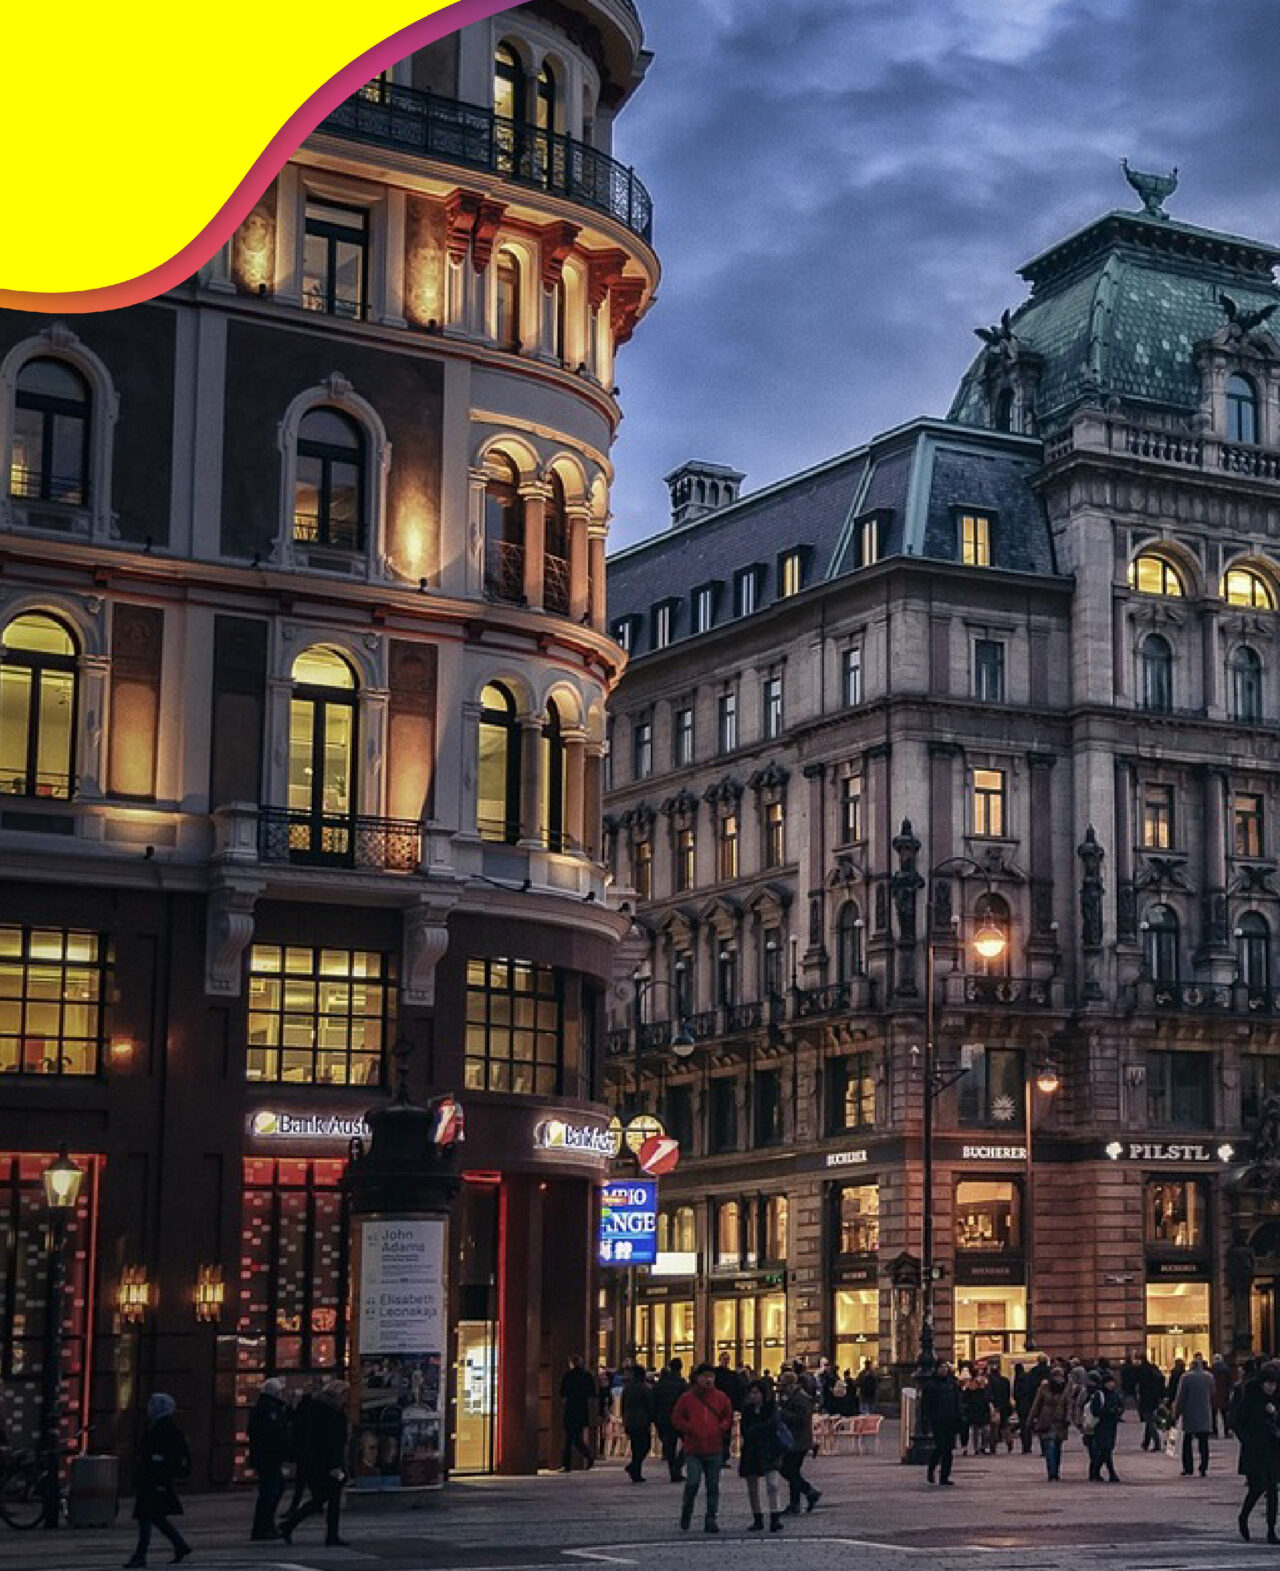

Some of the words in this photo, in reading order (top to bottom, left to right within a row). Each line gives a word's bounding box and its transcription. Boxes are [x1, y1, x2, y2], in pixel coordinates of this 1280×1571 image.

[278, 1113, 323, 1134] Bank
[962, 1145, 1027, 1159] BUCHERER
[1129, 1143, 1210, 1160] PILSTL
[381, 1229, 413, 1241] John
